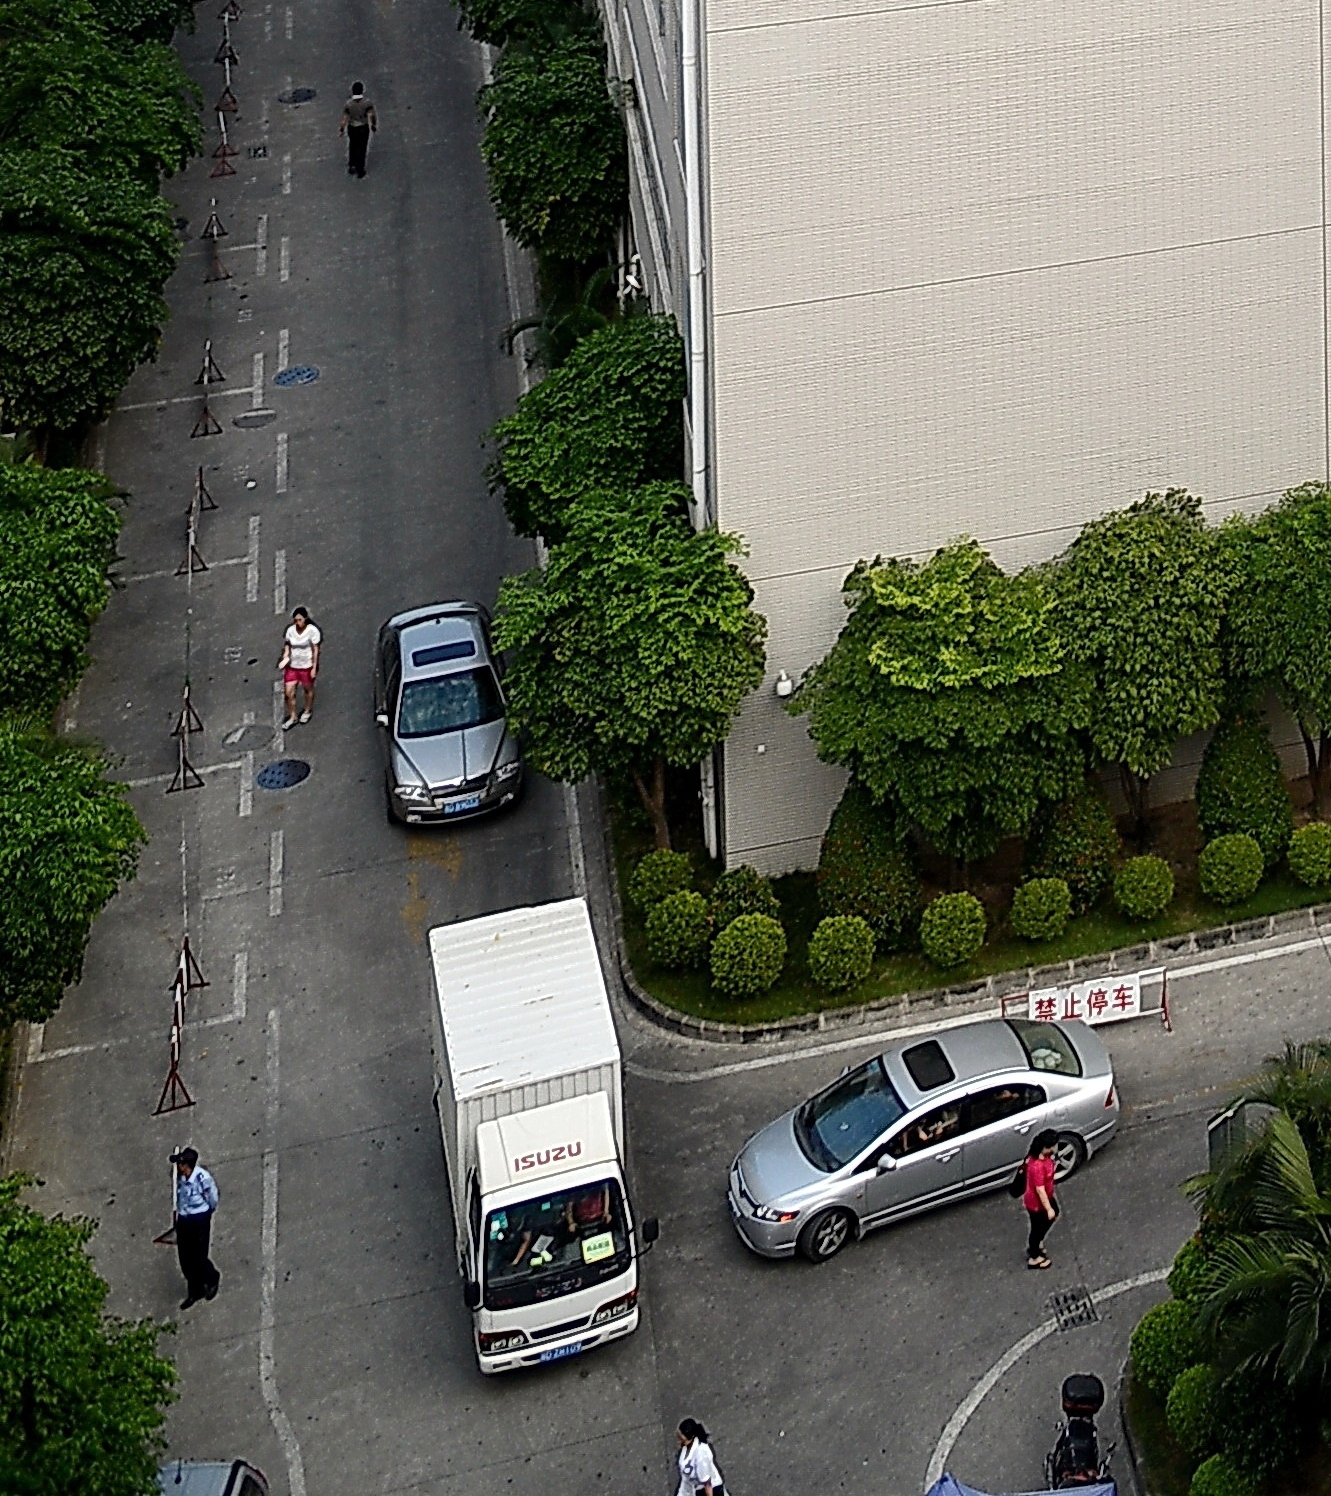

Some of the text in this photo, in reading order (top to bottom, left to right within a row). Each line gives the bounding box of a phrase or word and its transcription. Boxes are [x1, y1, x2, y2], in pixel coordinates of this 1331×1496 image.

[1035, 984, 1134, 1020] 禁止停车
[514, 1141, 582, 1172] ISUZU
